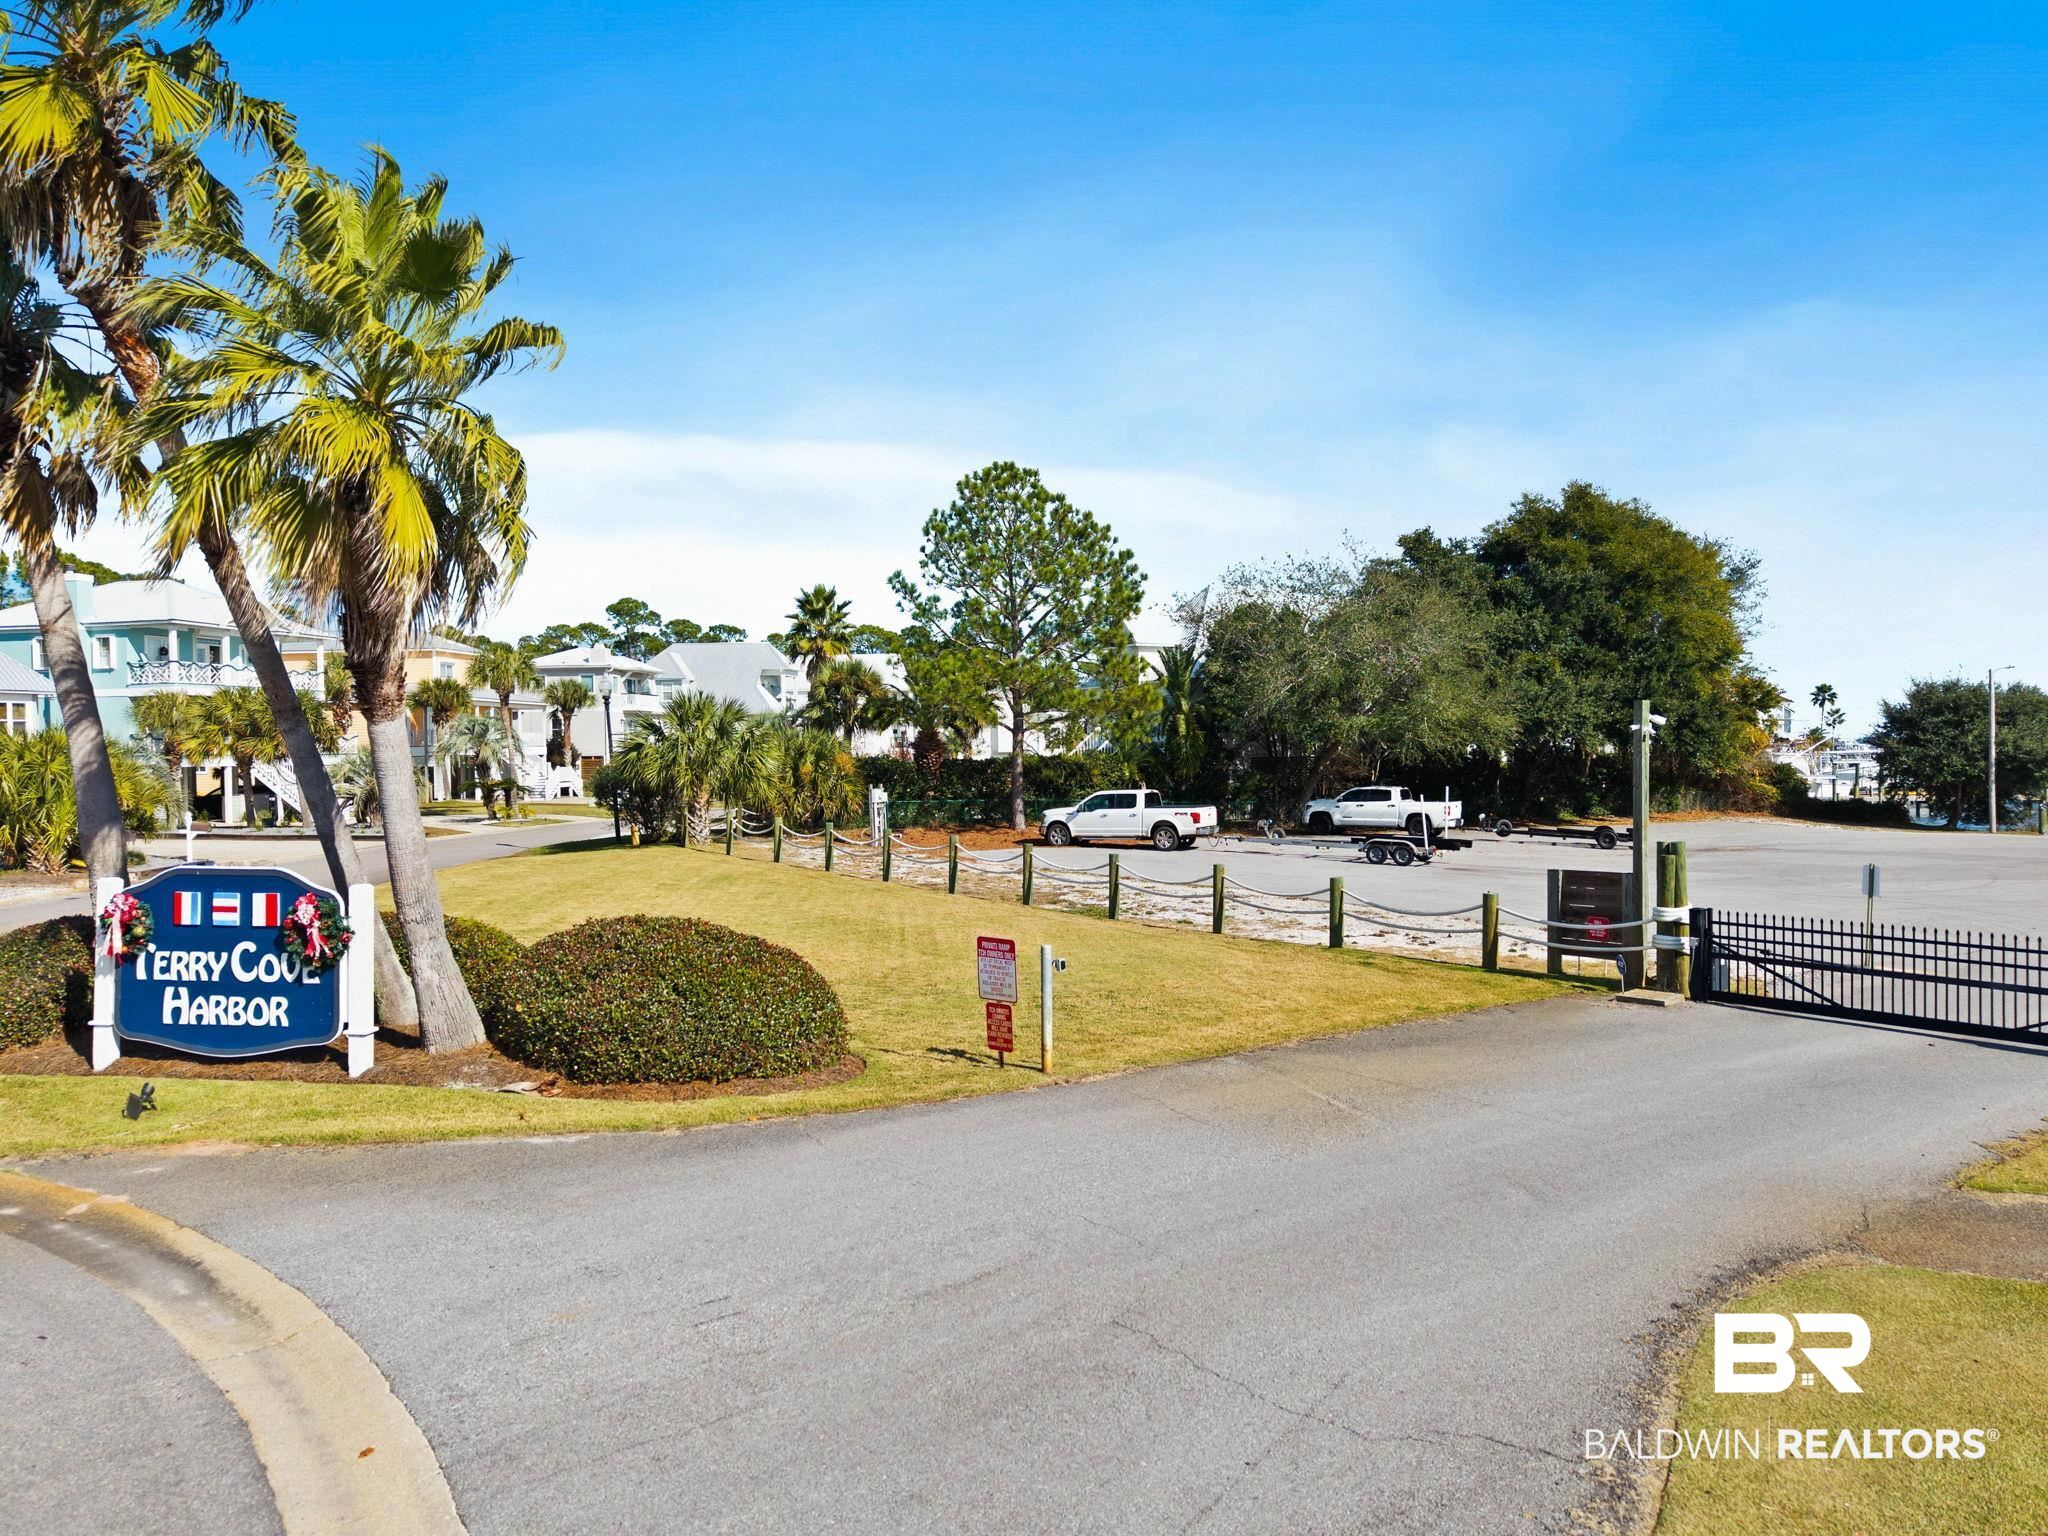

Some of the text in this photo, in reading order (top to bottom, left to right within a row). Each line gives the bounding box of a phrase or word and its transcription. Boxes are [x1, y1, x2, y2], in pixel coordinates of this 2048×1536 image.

[981, 941, 1010, 951] PRIVATE RAMP
[986, 949, 1004, 959] OWNERS
[1004, 952, 1014, 960] ONLY
[136, 942, 228, 982] TERRY
[162, 986, 289, 1027] HARBOR
